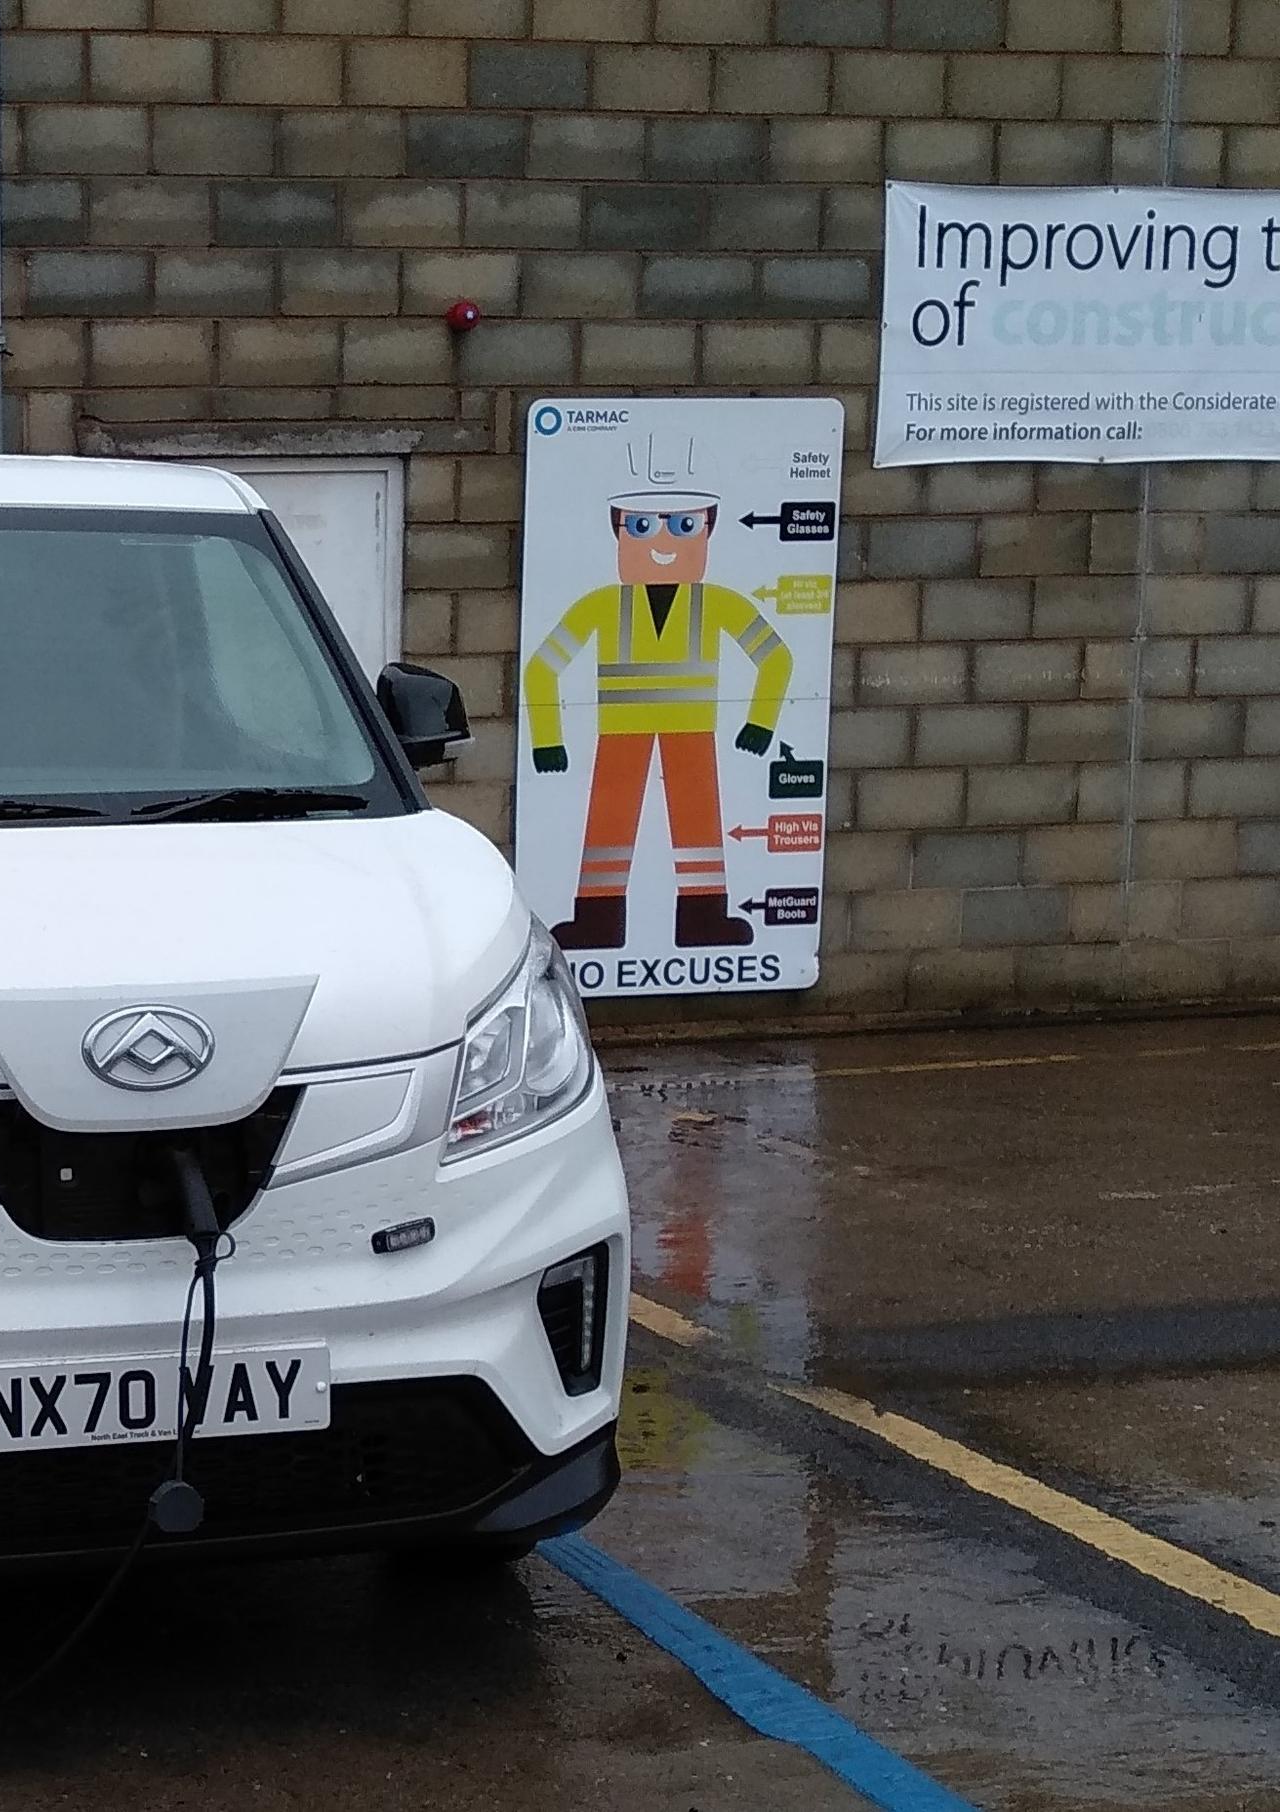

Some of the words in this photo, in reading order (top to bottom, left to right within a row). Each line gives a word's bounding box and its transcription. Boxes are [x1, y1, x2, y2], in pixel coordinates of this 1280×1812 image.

[917, 204, 1240, 289] Improving
[911, 279, 981, 347] of
[906, 393, 944, 412] This
[947, 393, 978, 412] site
[982, 393, 996, 411] is
[999, 393, 1089, 418] registered
[1094, 392, 1134, 411] with
[1138, 391, 1168, 410] the
[1172, 391, 1277, 411] Considerate
[566, 410, 629, 424] TARMAC
[905, 423, 936, 442] For
[939, 427, 989, 442] more
[992, 423, 1102, 442] information
[1105, 423, 1144, 441] call:
[792, 451, 830, 466] Safety
[789, 466, 831, 479] Helmet
[792, 509, 826, 522] Safety
[786, 522, 830, 535] Glasses
[778, 772, 815, 785] Gloves
[774, 821, 799, 834] High
[800, 820, 818, 832] Vis
[773, 834, 820, 846] Trousers
[768, 896, 817, 909] MetGuard
[776, 908, 807, 920] Boots
[570, 960, 604, 990] O
[617, 954, 781, 988] EXCUSES
[91, 1433, 111, 1441] North
